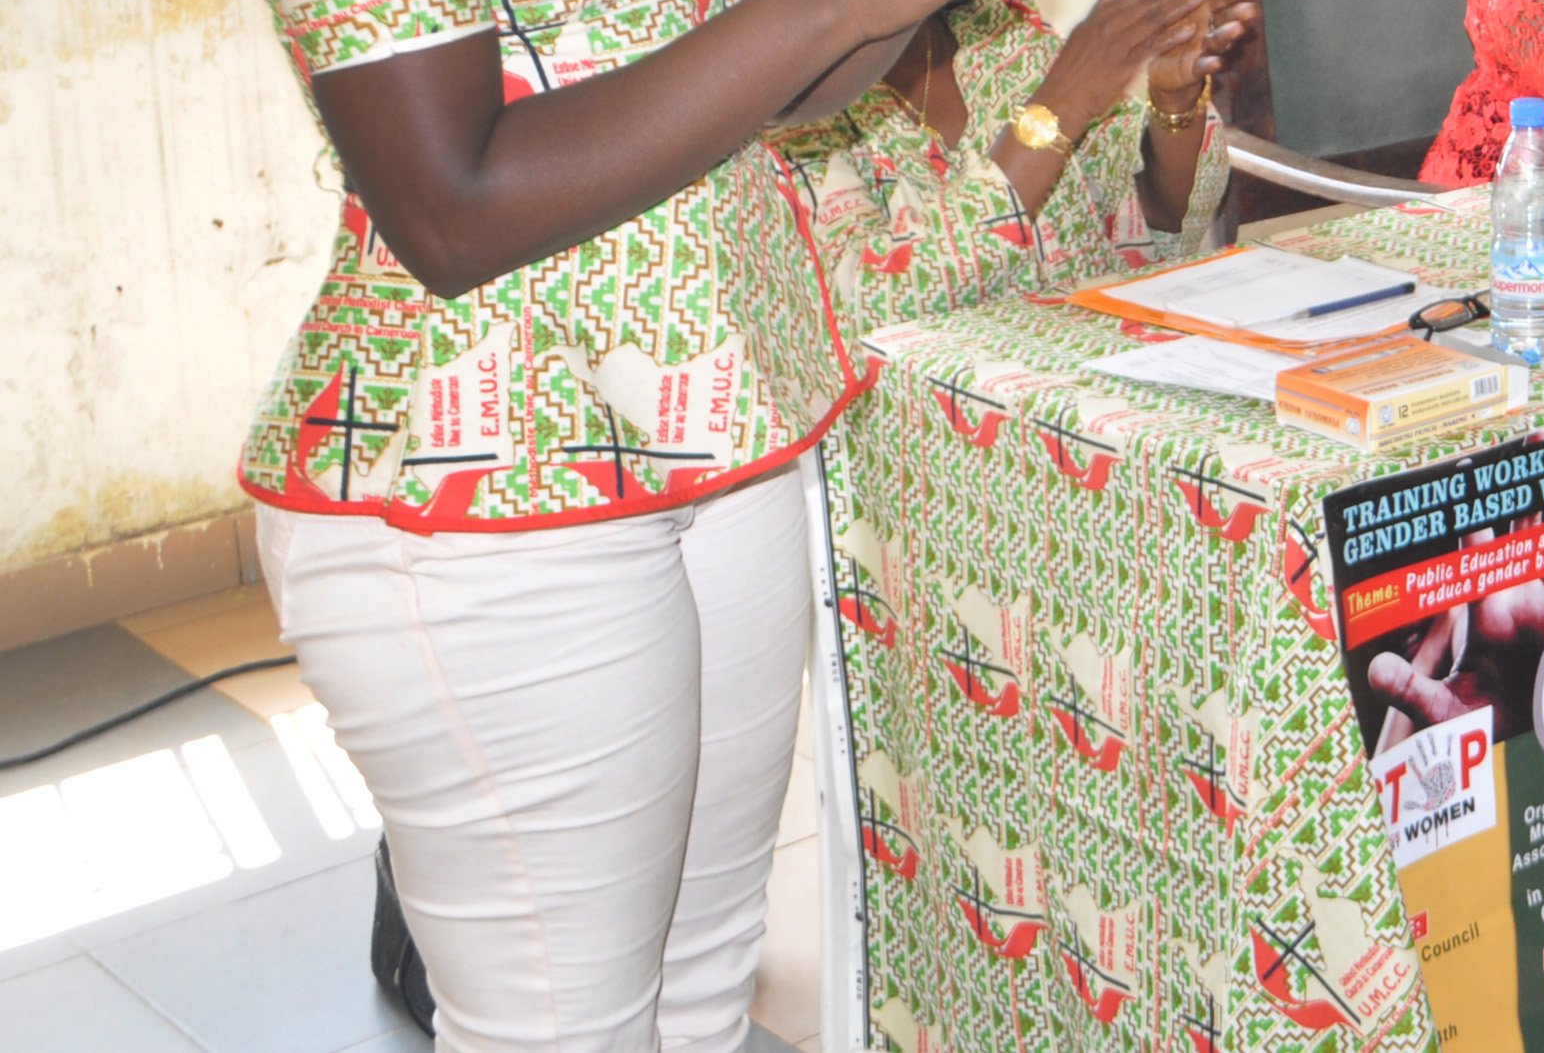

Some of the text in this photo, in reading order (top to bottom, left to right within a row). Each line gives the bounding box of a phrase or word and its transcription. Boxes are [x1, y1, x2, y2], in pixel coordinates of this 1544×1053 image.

[1398, 404, 1409, 419] 12
[1343, 473, 1466, 532] TRAINING
[1343, 507, 1446, 566] GENDER
[1454, 484, 1533, 530] BASED
[1347, 583, 1400, 615] Theme:
[1405, 559, 1454, 592] Public
[1459, 539, 1533, 574] Education
[1418, 578, 1473, 609] reduce
[1477, 557, 1530, 598] gender
[1404, 796, 1477, 843] WOMEN
[1526, 889, 1541, 907] in
[1421, 922, 1480, 961] Council
